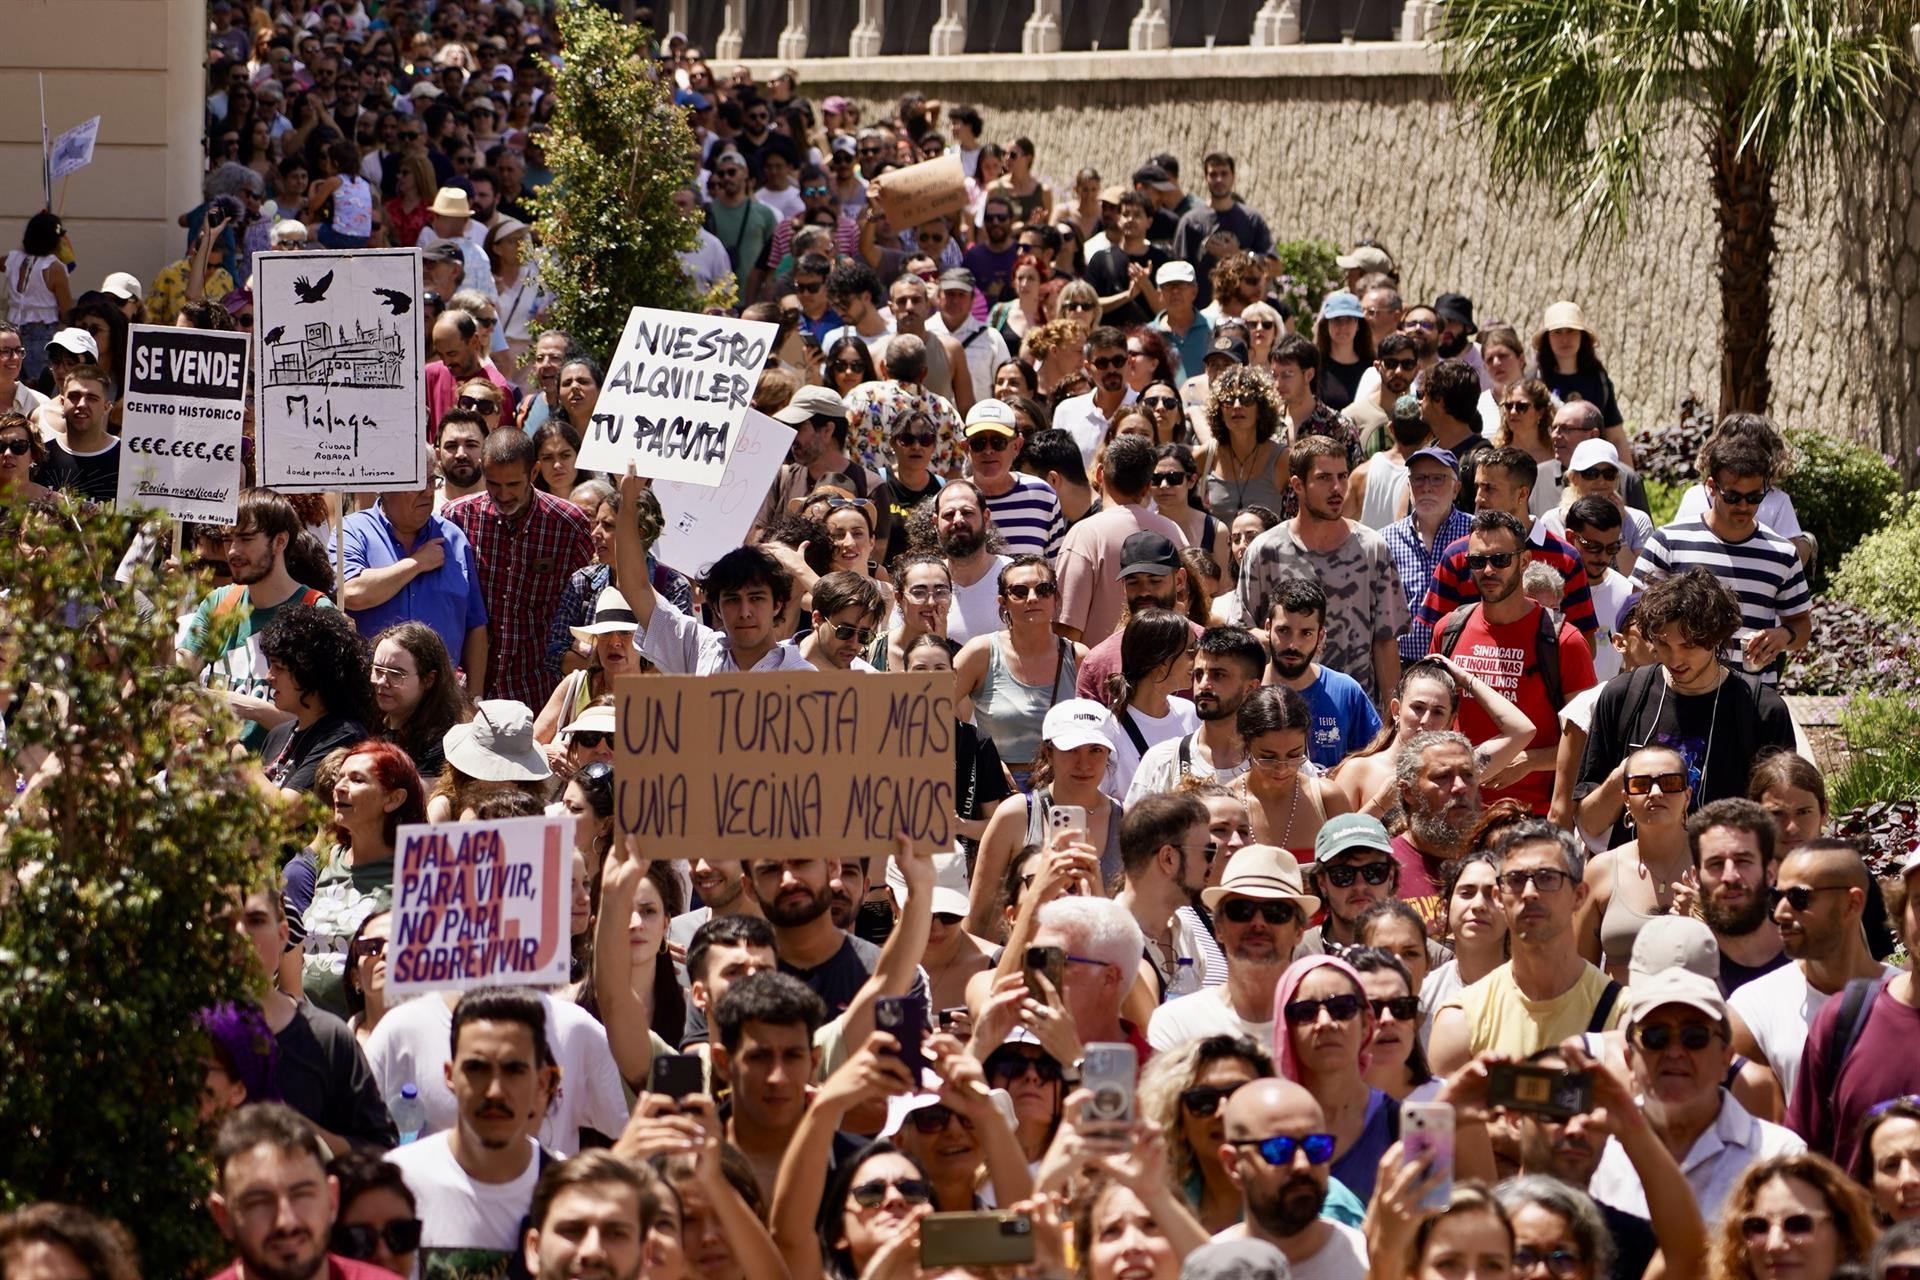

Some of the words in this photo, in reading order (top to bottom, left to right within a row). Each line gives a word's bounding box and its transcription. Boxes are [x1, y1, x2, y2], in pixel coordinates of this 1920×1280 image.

[135, 345, 163, 381] SE
[170, 349, 241, 387] VENDE
[635, 320, 766, 370] NUESTRO
[608, 361, 750, 410] ALQUILER
[127, 402, 175, 416] CENTRO
[179, 406, 241, 421] HISTORICO
[287, 394, 377, 457] Málaga
[314, 452, 351, 461] ROBADA
[592, 413, 624, 443] TU
[634, 415, 730, 465] PAGUITA
[286, 466, 311, 477] donde
[361, 466, 395, 477] turismo
[1456, 657, 1466, 668] DE
[1467, 658, 1521, 673] INQUILINAS
[1473, 645, 1524, 660] SINDICATO
[623, 690, 682, 755] UN
[711, 684, 858, 755] TURISTA
[878, 682, 952, 758] MÁS
[1318, 717, 1337, 726] TEIDE
[618, 774, 687, 837] UNA
[713, 772, 821, 839] VECINA
[842, 774, 952, 846] MENOS
[963, 786, 975, 815] LULA
[402, 827, 500, 870] MÁLAGA
[400, 871, 466, 907] PARA
[478, 863, 537, 900] VIVIR,
[397, 911, 437, 945] NO
[442, 904, 500, 943] PARA
[394, 938, 538, 983] SOBREVIVIR
